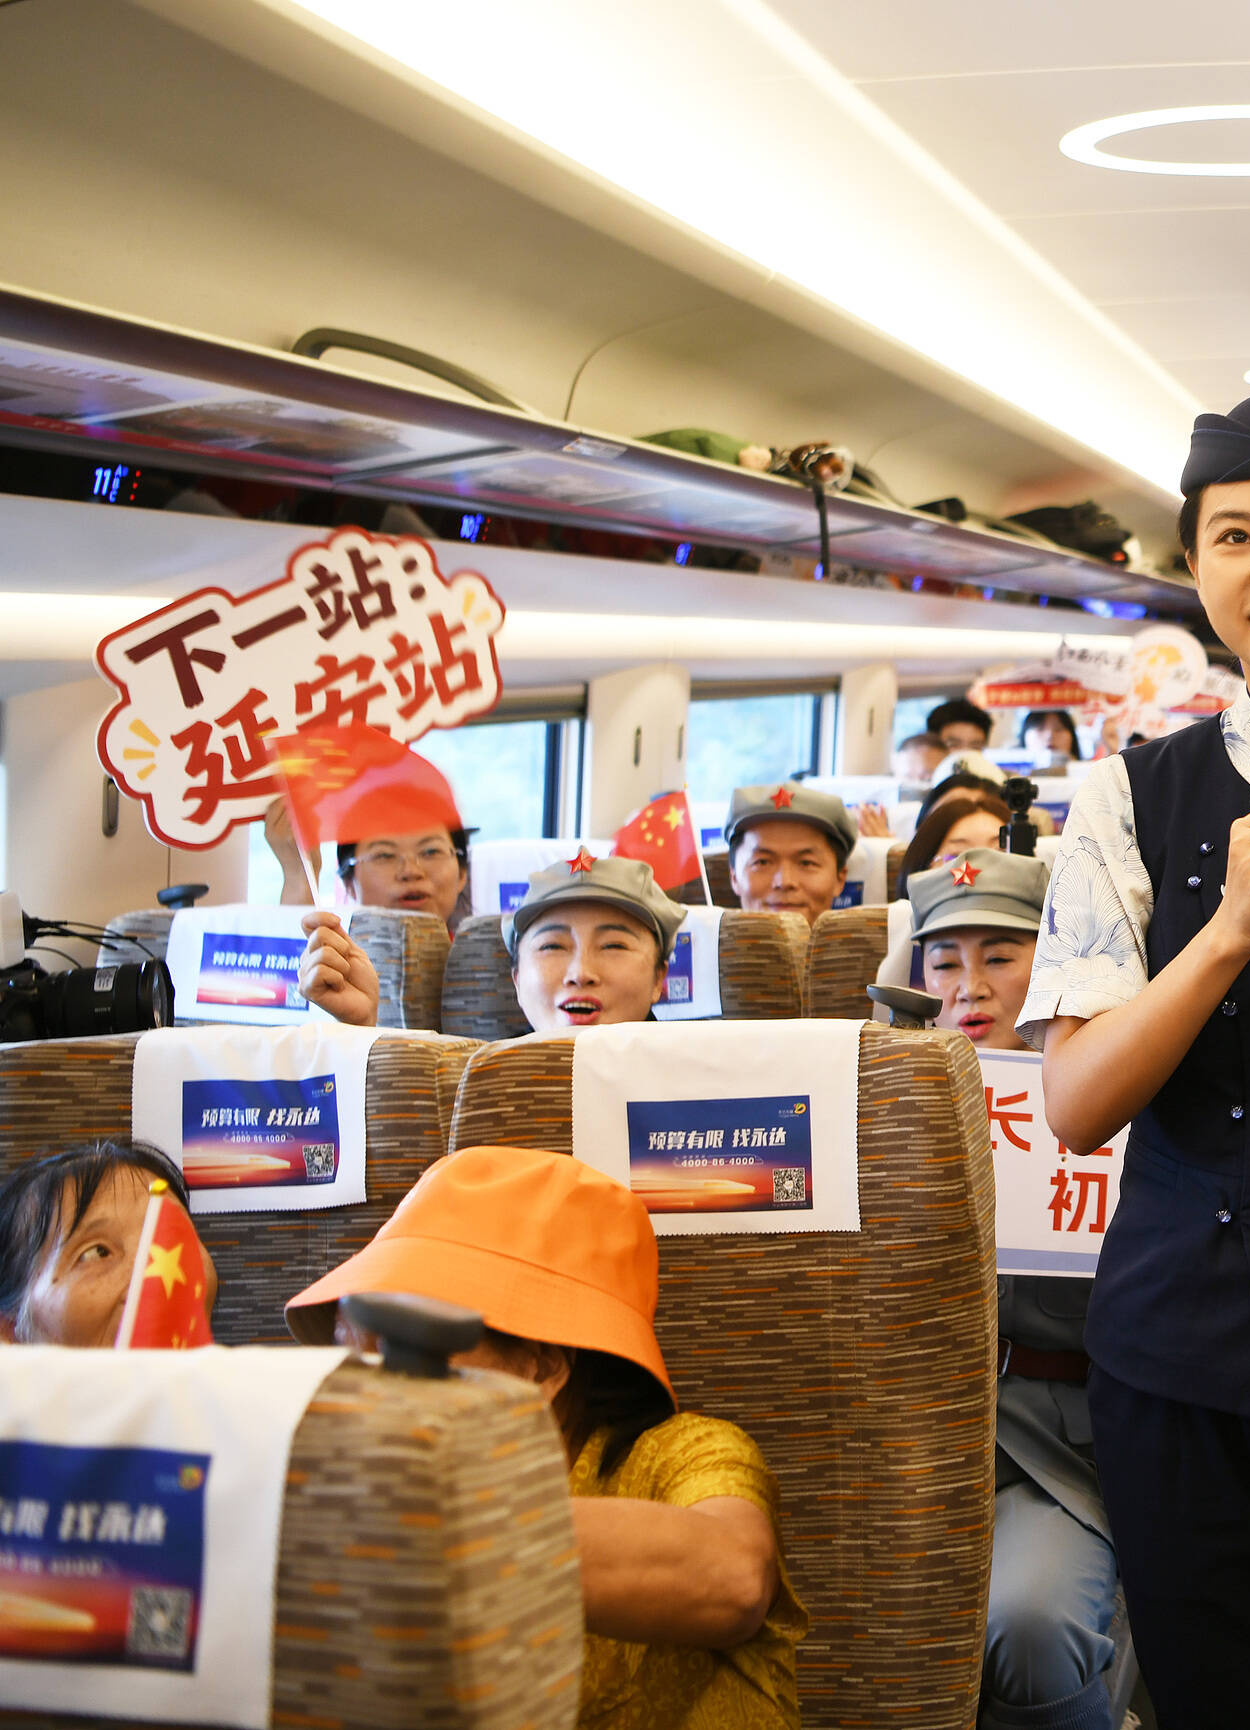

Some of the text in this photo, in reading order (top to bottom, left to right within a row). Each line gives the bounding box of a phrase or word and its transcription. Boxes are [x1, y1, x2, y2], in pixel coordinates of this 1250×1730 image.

[93, 467, 111, 496] 11
[170, 611, 483, 826] 延安站
[201, 1106, 320, 1127] 预算有限 找永达
[648, 1126, 786, 1150] 预算有限 找永达
